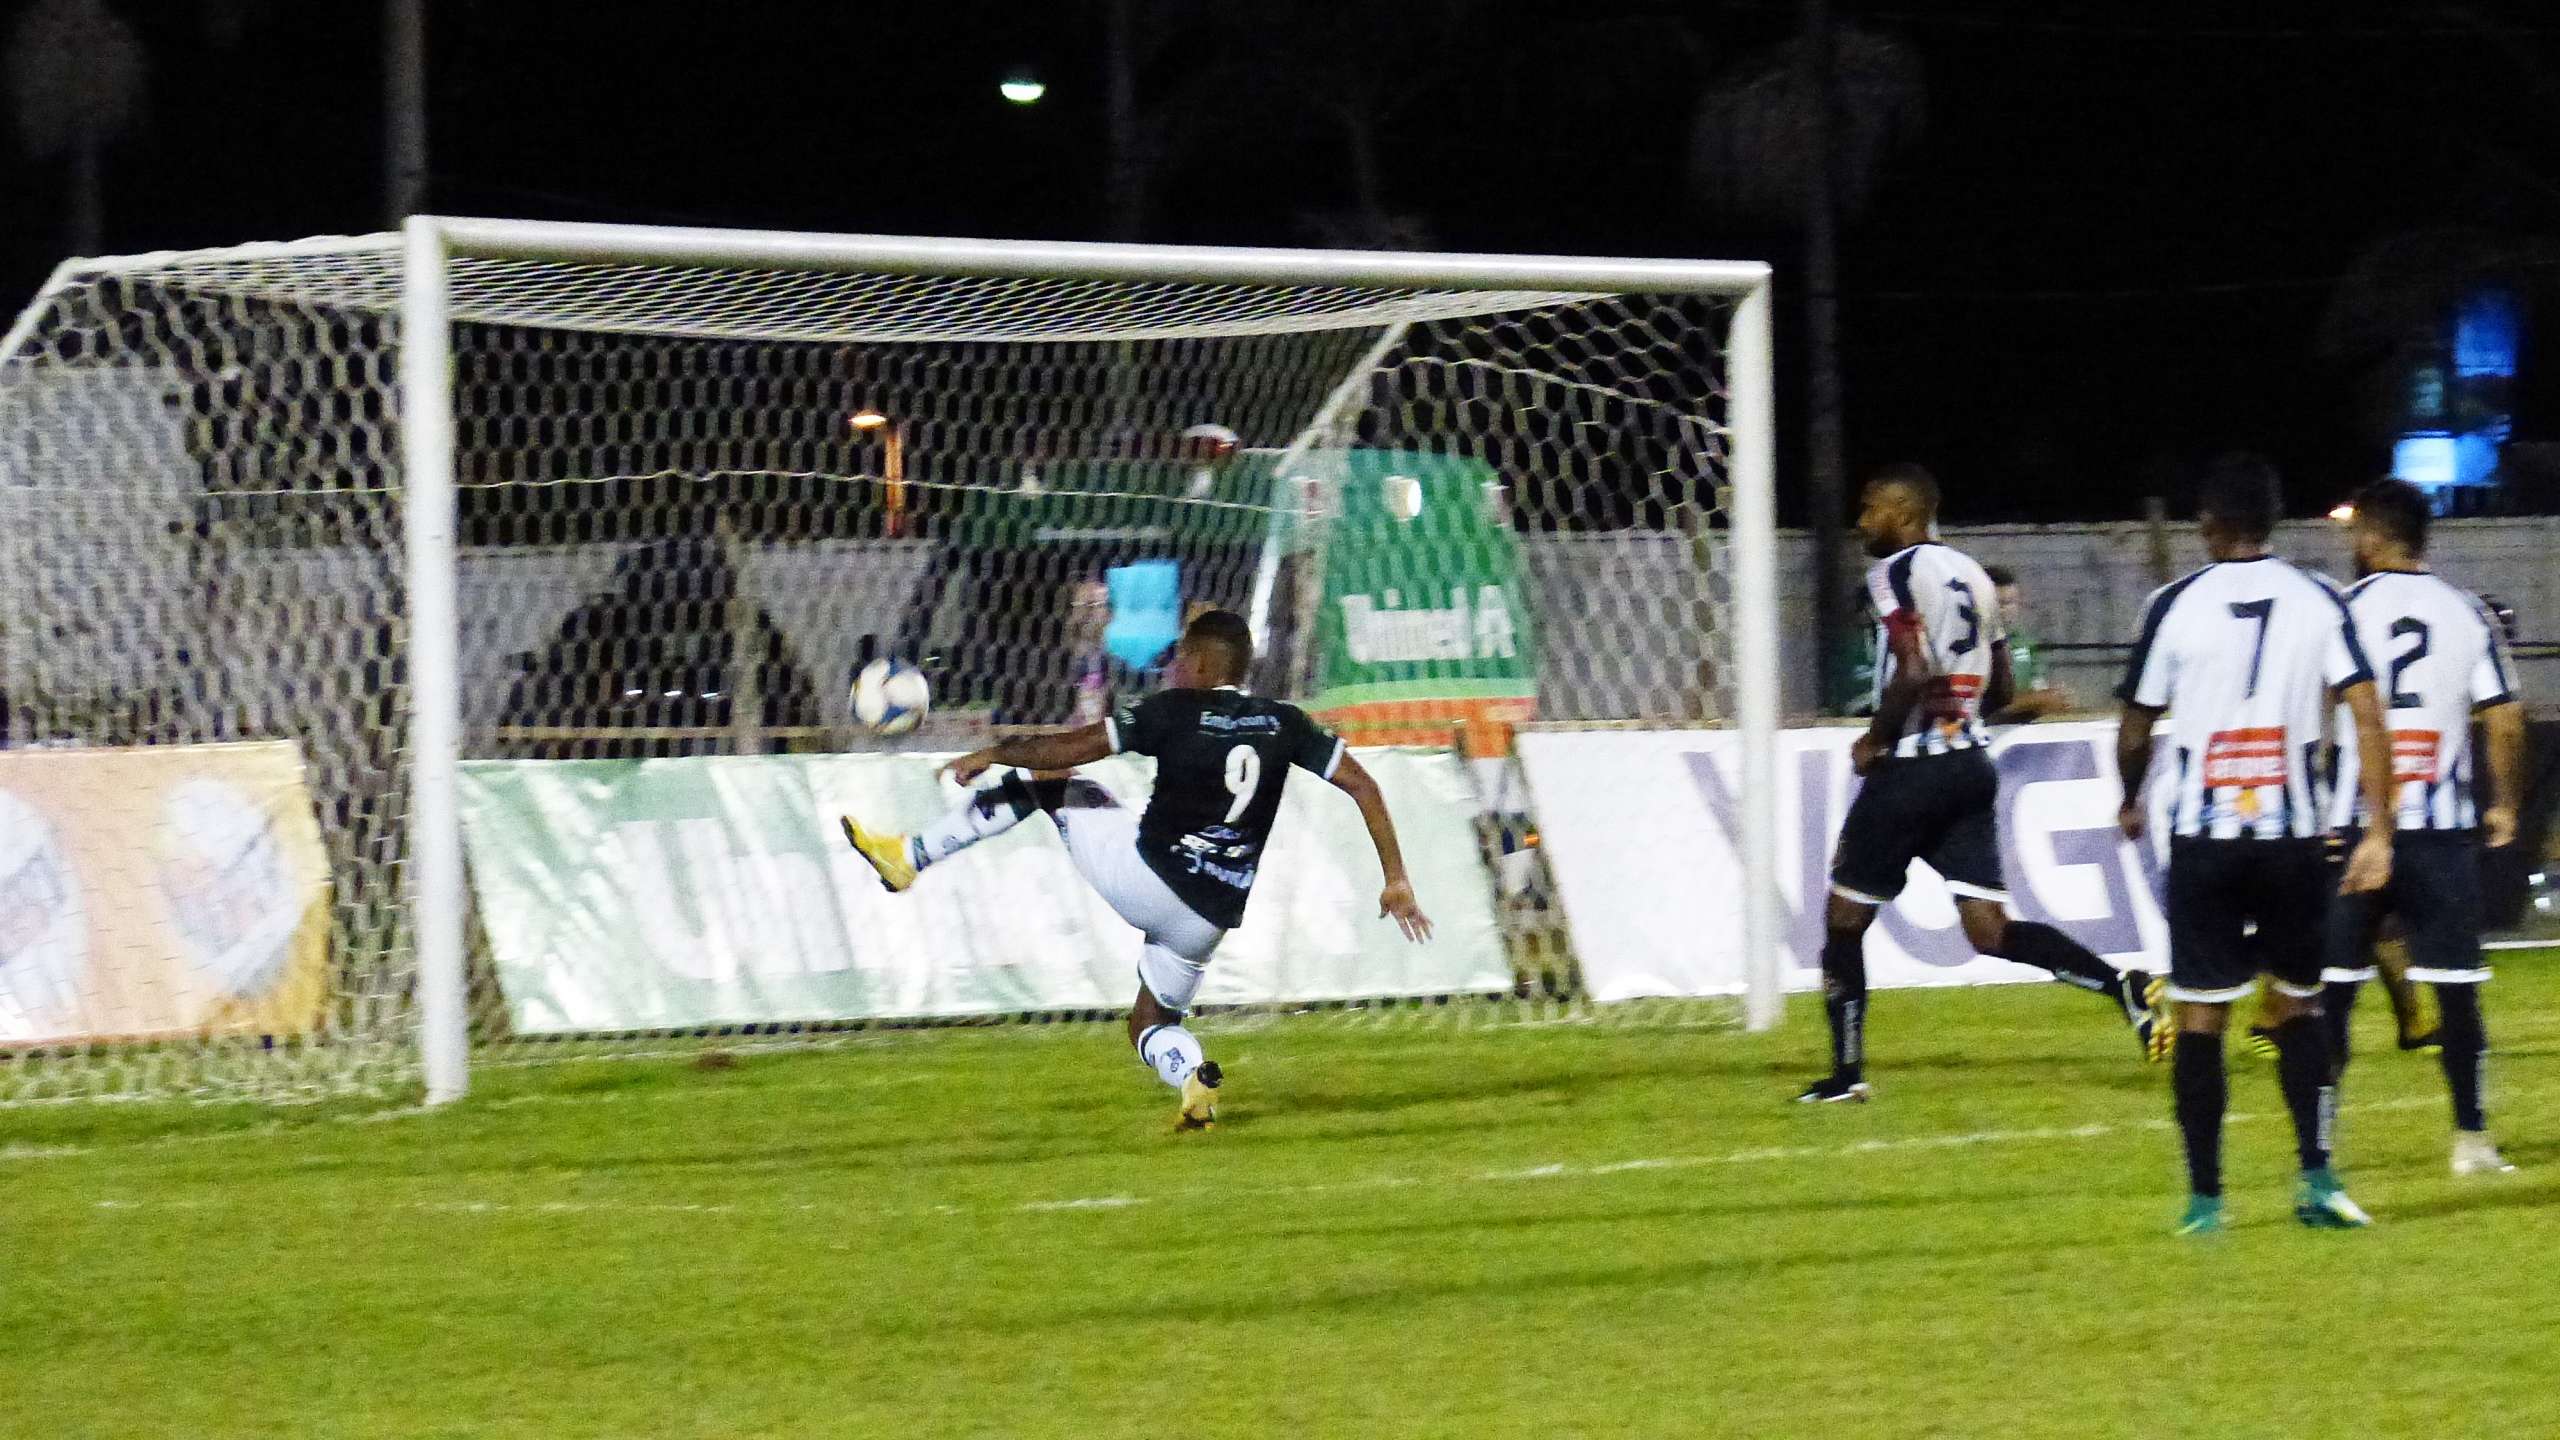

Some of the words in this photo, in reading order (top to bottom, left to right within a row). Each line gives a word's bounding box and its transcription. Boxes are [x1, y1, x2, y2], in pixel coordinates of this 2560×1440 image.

[1946, 577, 1980, 655] 3
[2231, 598, 2275, 699] 7
[2389, 616, 2429, 708] 2
[1223, 744, 1261, 823] 9
